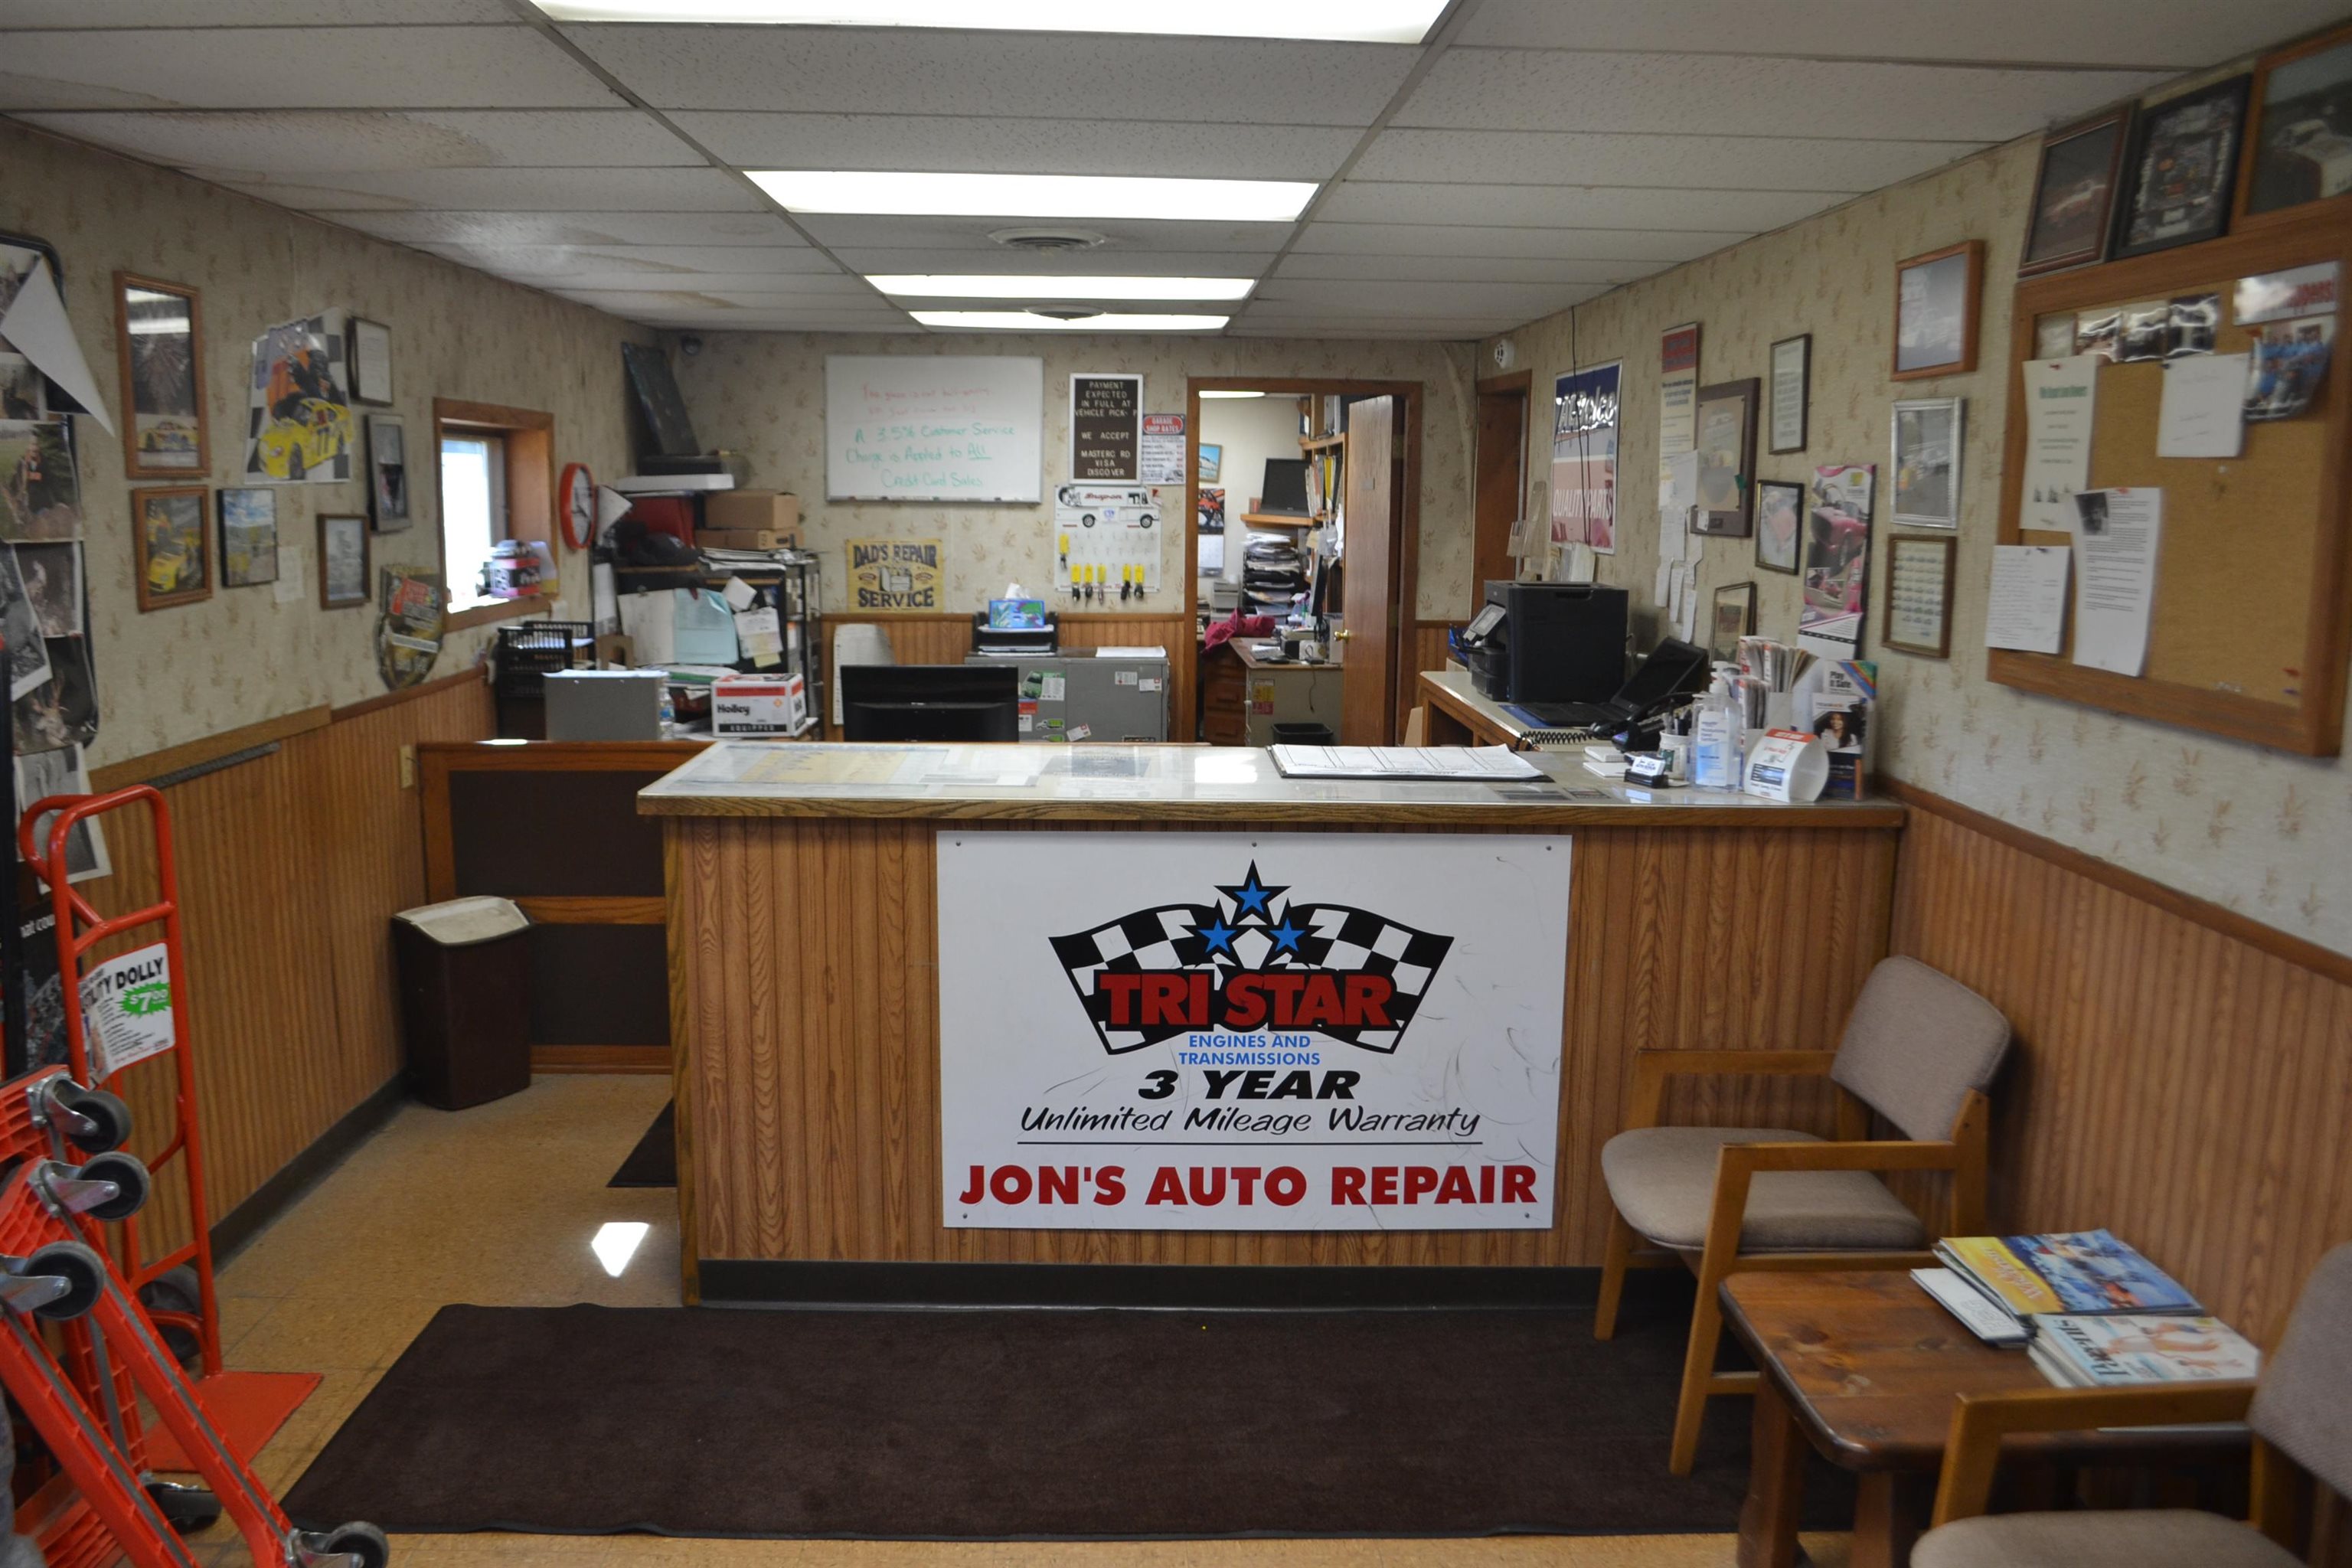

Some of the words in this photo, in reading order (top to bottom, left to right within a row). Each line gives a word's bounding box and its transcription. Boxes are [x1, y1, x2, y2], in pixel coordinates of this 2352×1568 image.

[1075, 409, 1104, 417] VEHICLE
[1081, 400, 1089, 408] IN
[1095, 400, 1115, 408] FULL
[972, 422, 1015, 436] Service
[1553, 488, 1586, 517] QUALITY
[1586, 488, 1612, 520] PARTS
[853, 544, 888, 569] DAD'S
[893, 544, 937, 569] REPAIR
[858, 586, 934, 608] SERVICE
[717, 704, 750, 717] Holley
[116, 956, 164, 990] DOLLY
[1099, 974, 1210, 1026] TRI
[1225, 973, 1392, 1027] STAR
[1188, 1034, 1266, 1048] ENGINES
[1271, 1034, 1311, 1048] AND
[1178, 1052, 1321, 1066] TRANSMISSIONS
[1138, 1070, 1178, 1099] 3
[1203, 1070, 1361, 1099] YEAR
[1021, 1106, 1168, 1133] Unlimited
[1183, 1107, 1311, 1135] Mileage
[1328, 1106, 1479, 1136] Warranty
[959, 1165, 1126, 1206] JON'S
[1145, 1165, 1308, 1207] AUTO
[1330, 1165, 1537, 1204] REPAIR
[2053, 1319, 2132, 1375] Parents
